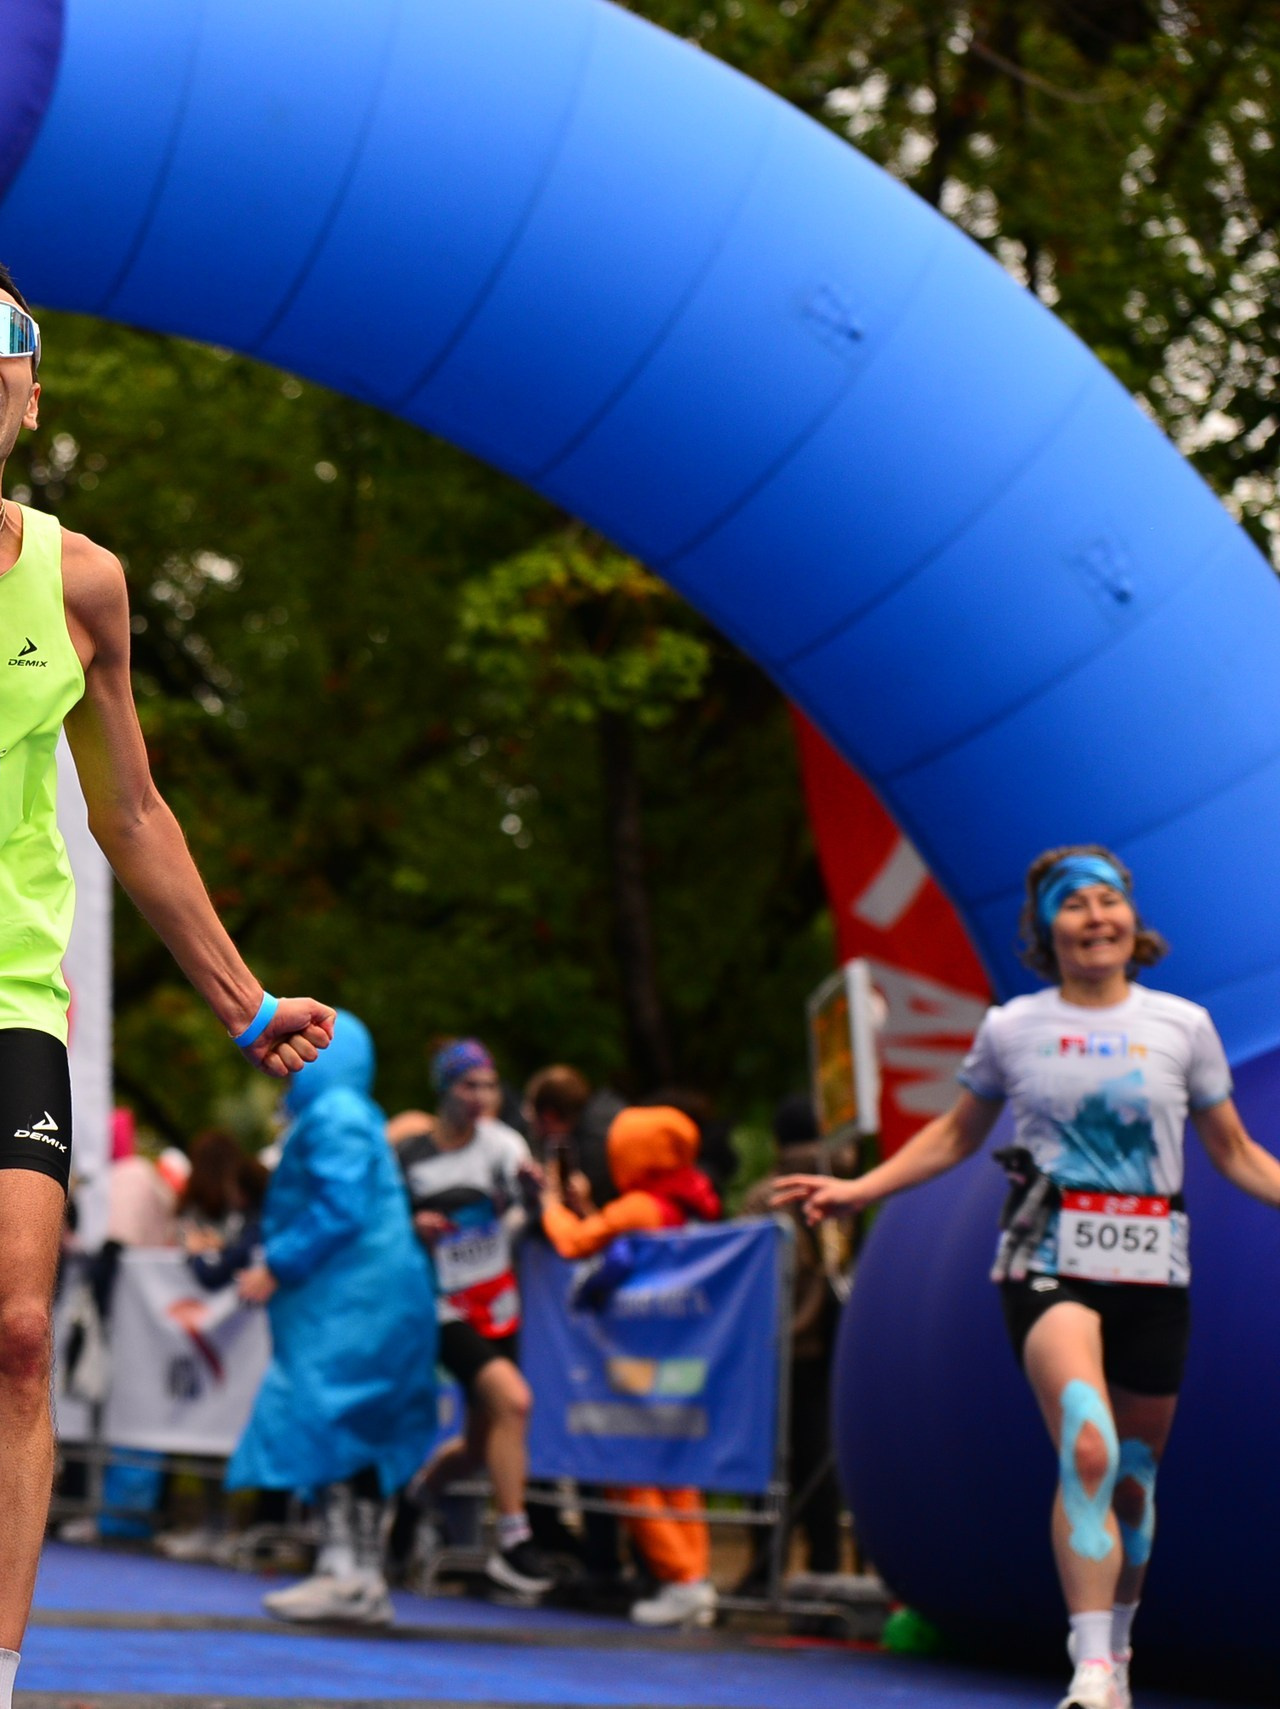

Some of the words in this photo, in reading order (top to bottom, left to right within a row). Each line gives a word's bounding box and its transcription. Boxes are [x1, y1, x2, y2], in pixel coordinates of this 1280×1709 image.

[8, 659, 48, 668] DEMIX
[13, 1129, 68, 1153] DEMIX
[1074, 1220, 1159, 1253] 5052
